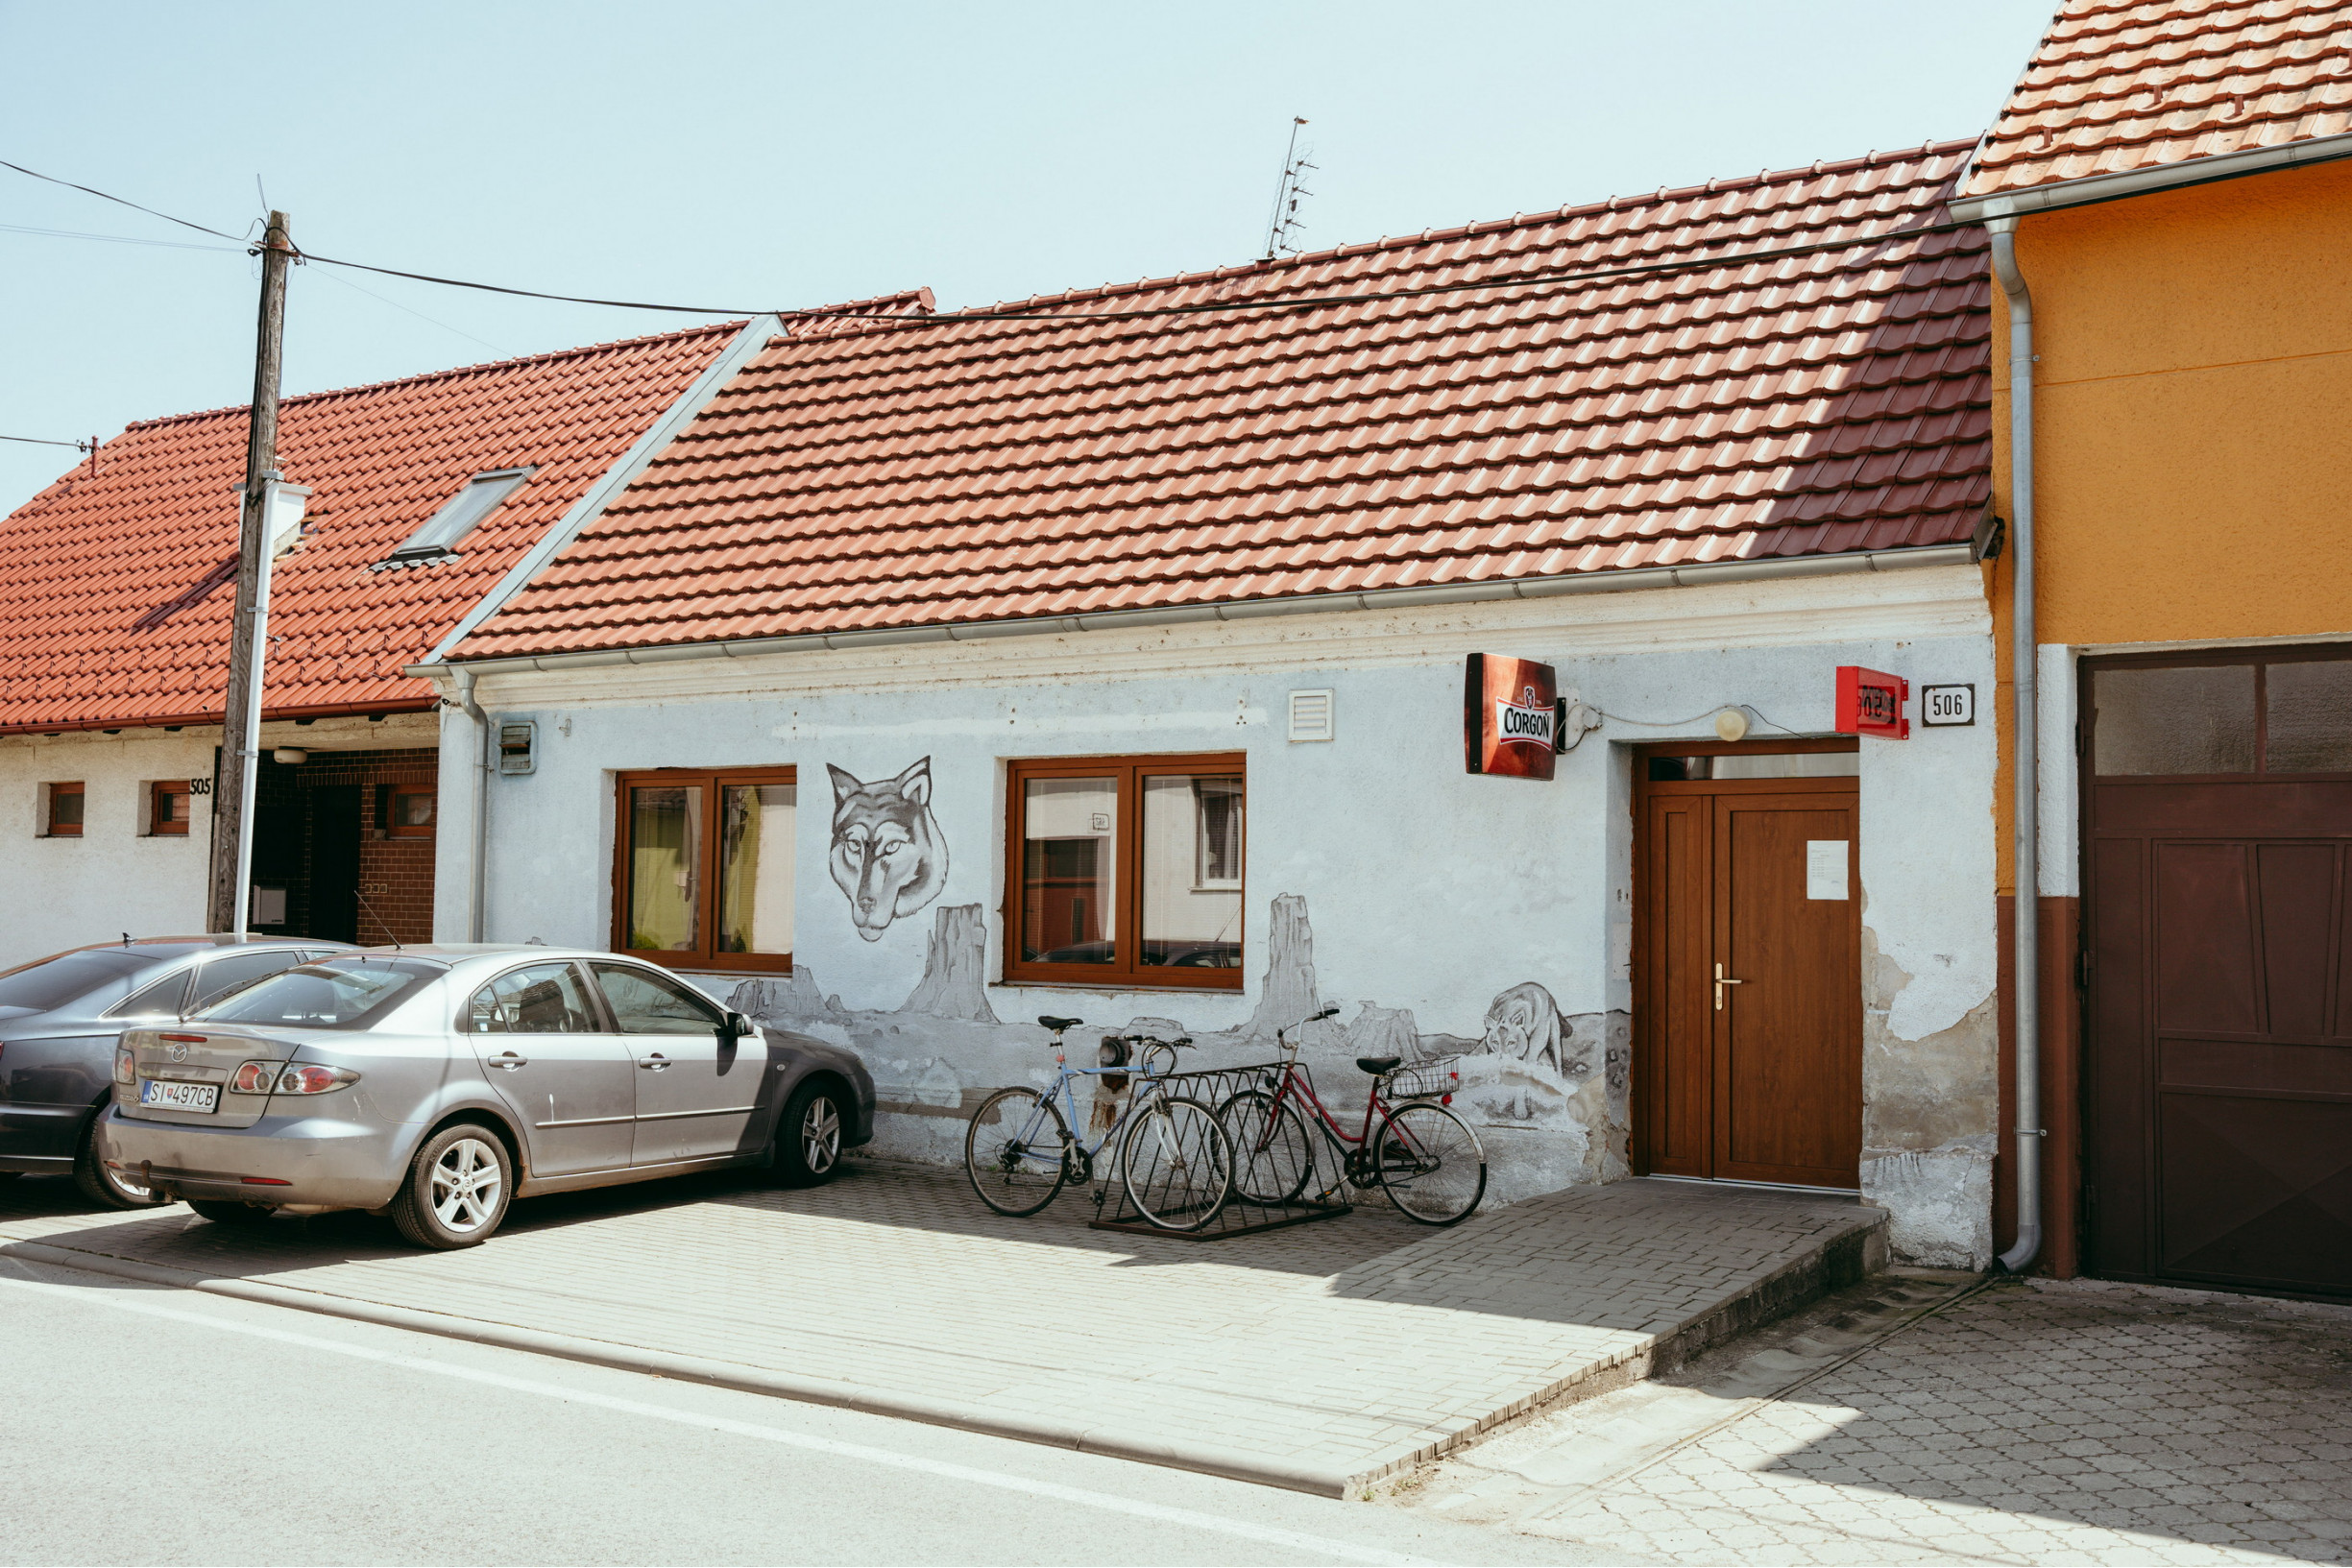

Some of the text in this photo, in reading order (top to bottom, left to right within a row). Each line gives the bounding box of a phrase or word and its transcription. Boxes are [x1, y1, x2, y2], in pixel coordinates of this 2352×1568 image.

[1933, 694, 1963, 715] 506
[1504, 707, 1549, 738] CORGOŇ
[190, 778, 211, 795] 505
[173, 1085, 214, 1106] 497CB
